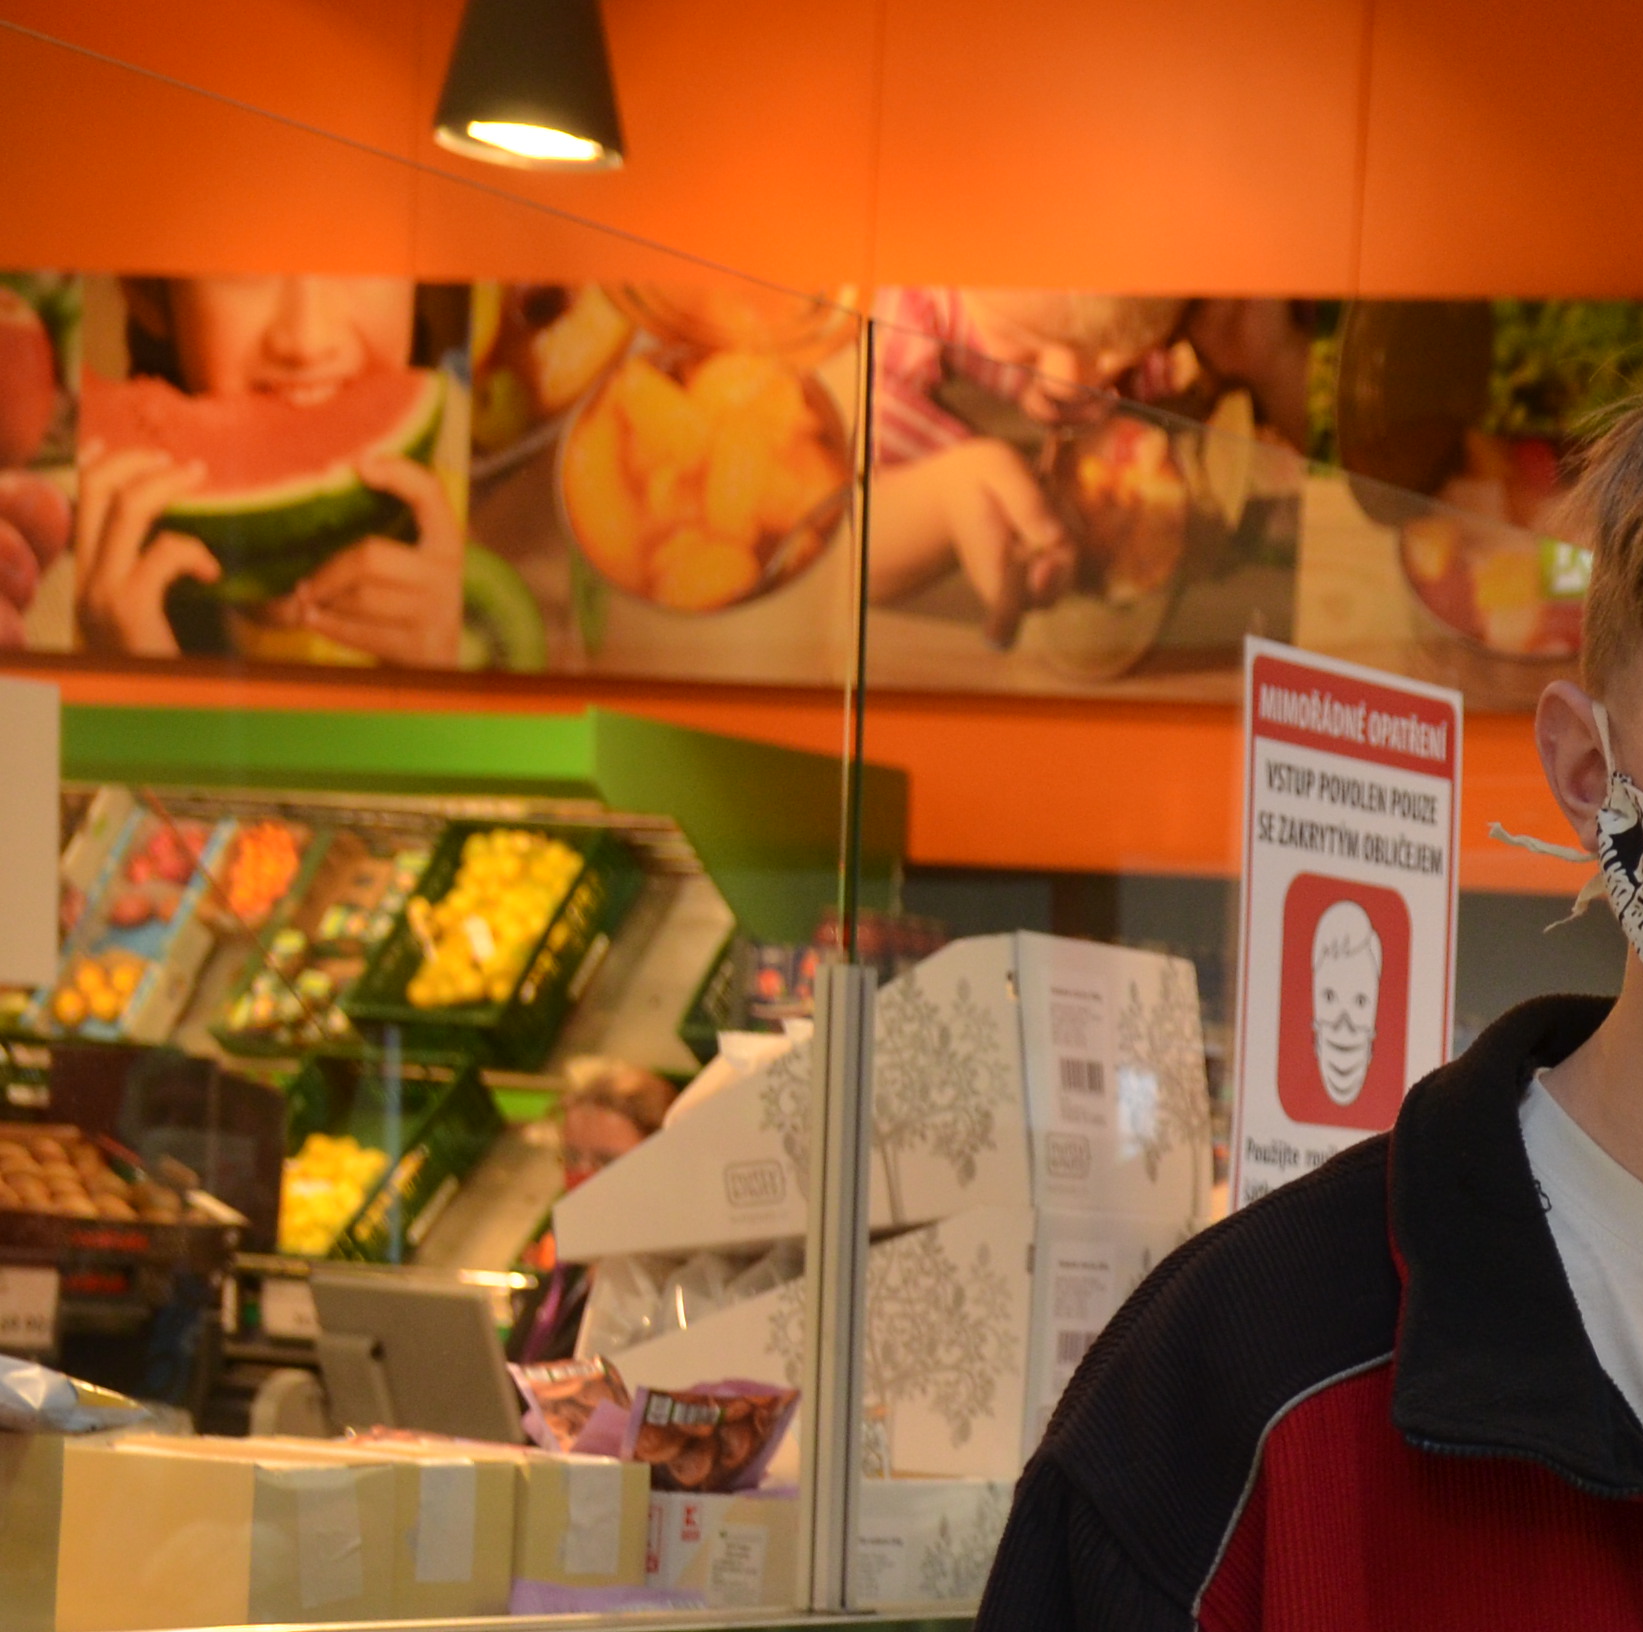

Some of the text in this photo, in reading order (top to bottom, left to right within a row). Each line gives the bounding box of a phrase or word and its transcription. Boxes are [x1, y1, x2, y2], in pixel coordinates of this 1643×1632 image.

[1259, 683, 1447, 764] MIMOŘÁDNÉ OPATŘENÍ
[1267, 758, 1438, 827] VSTUP POVOLEN POUZE
[1258, 810, 1444, 876] SE ZAKRYTÝM OBLIČEJEM
